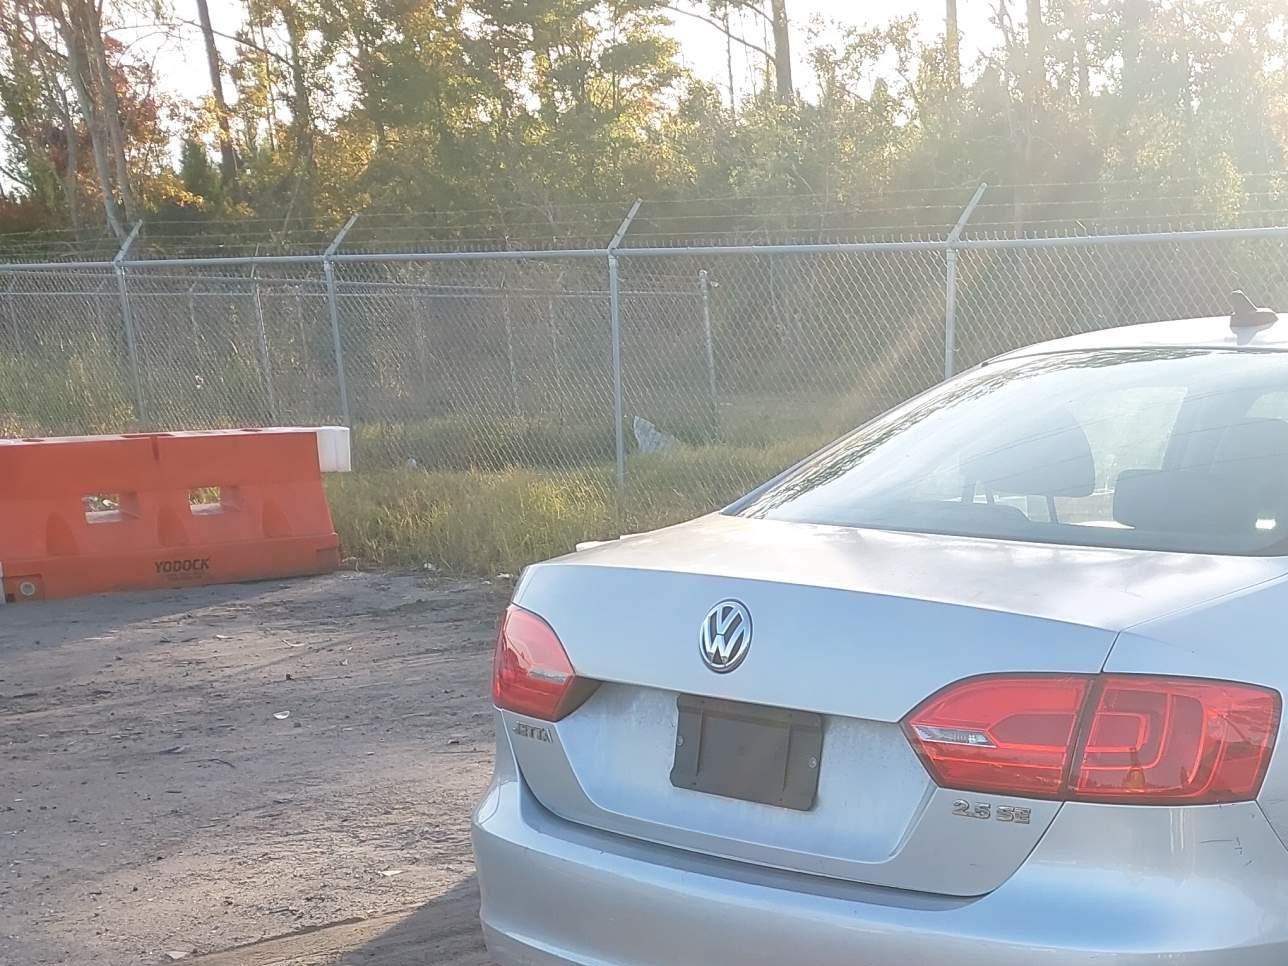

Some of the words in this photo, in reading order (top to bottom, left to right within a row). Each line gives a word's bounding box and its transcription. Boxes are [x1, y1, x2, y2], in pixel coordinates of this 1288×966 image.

[154, 558, 209, 574] YODOCK
[952, 799, 991, 819] 2.5
[996, 805, 1031, 825] SE
